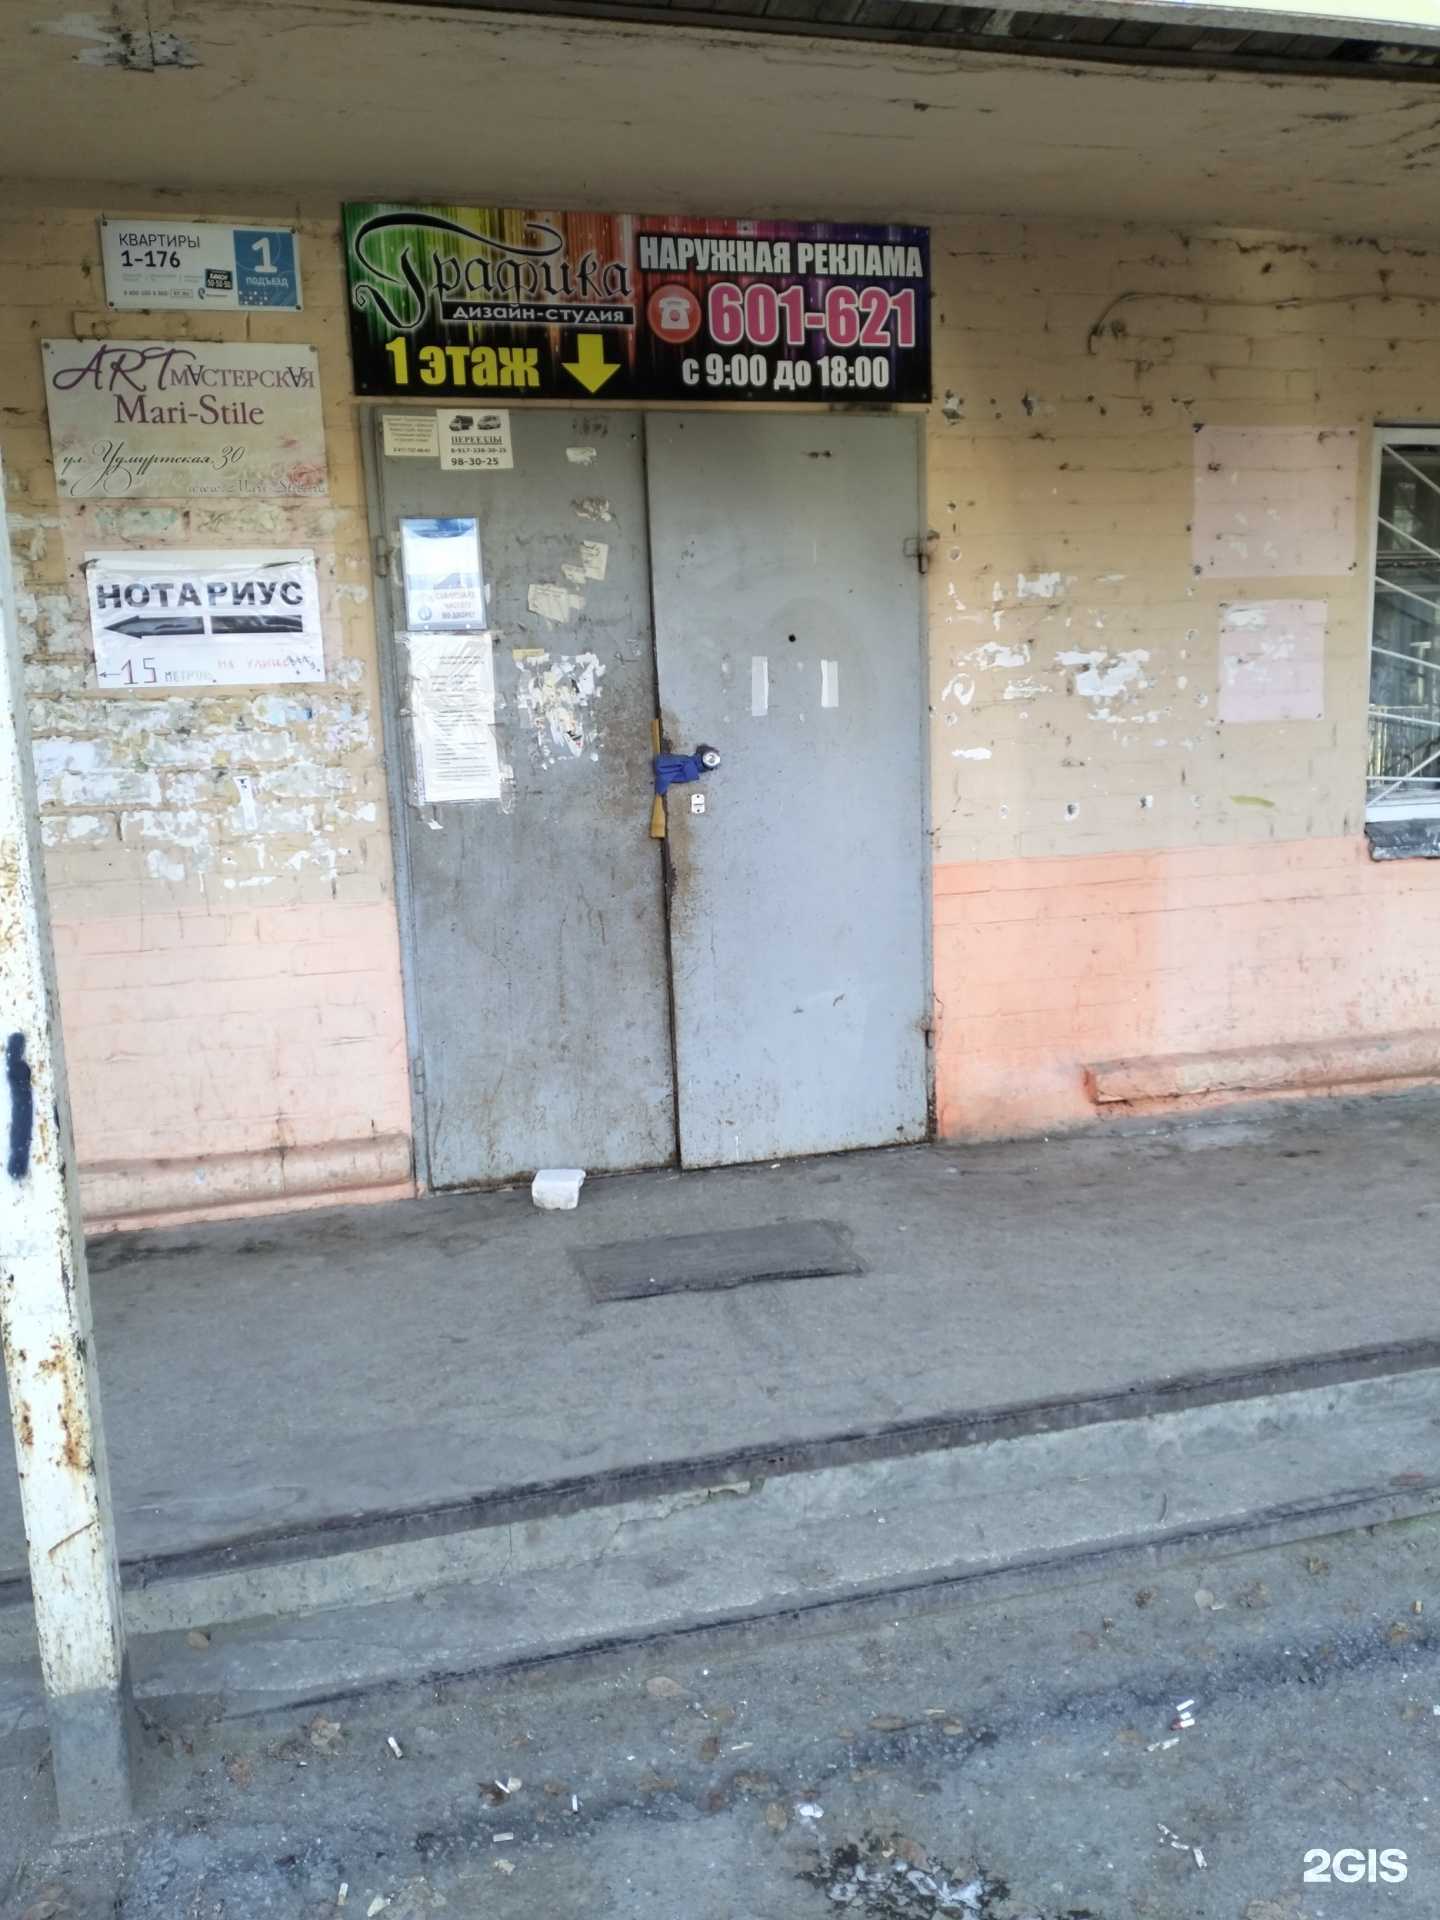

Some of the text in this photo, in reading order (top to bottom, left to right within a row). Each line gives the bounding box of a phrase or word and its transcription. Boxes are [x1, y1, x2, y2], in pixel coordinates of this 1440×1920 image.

[119, 233, 200, 249] КВАРТИРЫ
[252, 236, 278, 273] 1
[639, 236, 924, 278] НАРУЖНАЯ РЕКЛАМА
[121, 250, 181, 269] 1-176
[708, 282, 916, 347] 601-621
[385, 336, 540, 387] 1 этаж
[705, 353, 768, 386] 9:00
[773, 360, 812, 390] до
[817, 355, 890, 388] 18:00
[113, 393, 265, 425] Mari-Stile
[212, 446, 246, 471] 30
[96, 580, 304, 609] НОТАРИУС
[120, 657, 158, 685] 15
